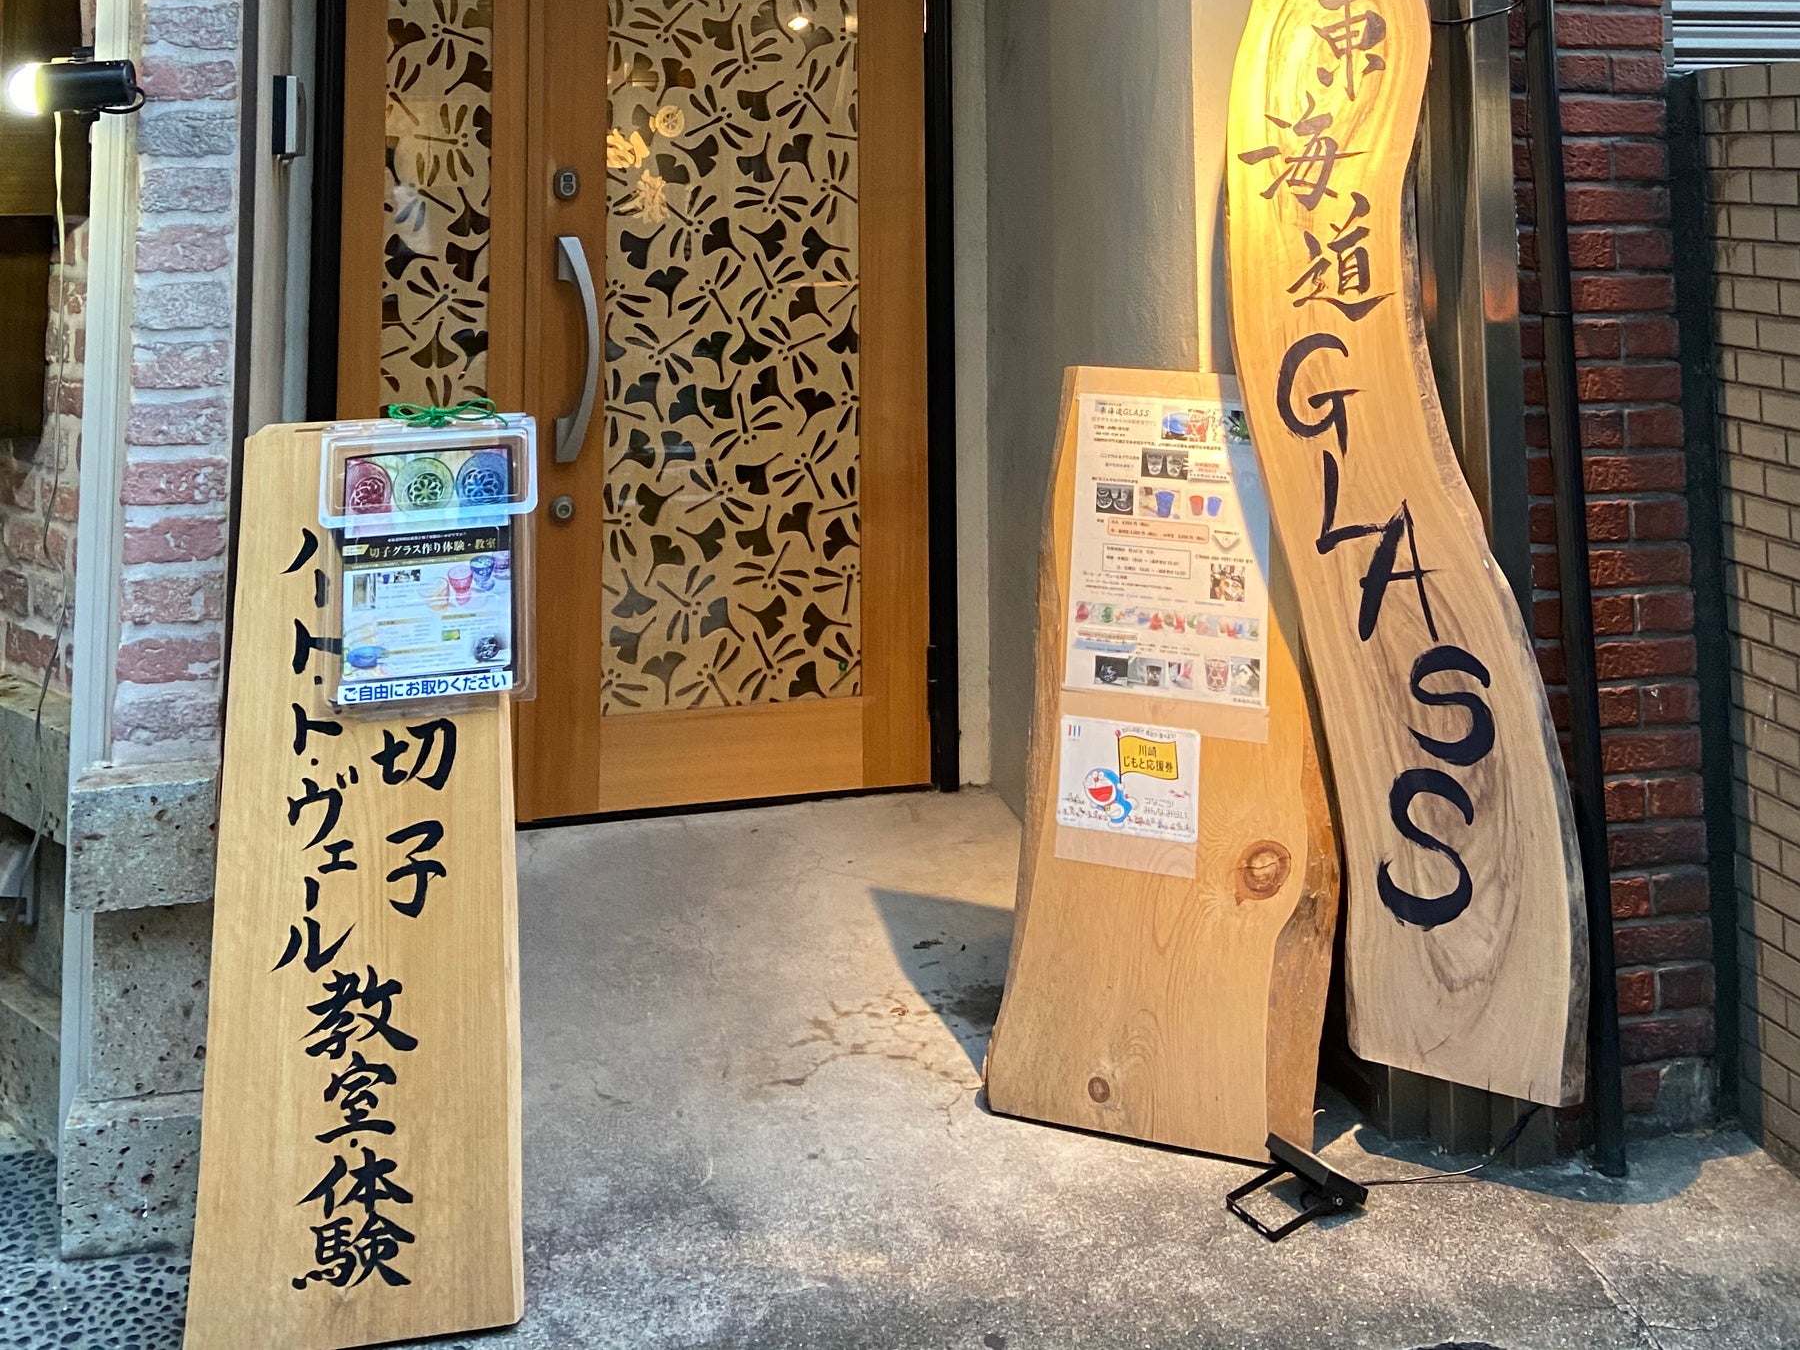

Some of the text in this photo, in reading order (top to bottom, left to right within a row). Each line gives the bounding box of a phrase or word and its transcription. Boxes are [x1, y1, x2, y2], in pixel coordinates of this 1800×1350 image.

[369, 538, 497, 558] 切子グラス作り体験・教室
[344, 674, 507, 702] ご自由にお取りください
[1138, 744, 1157, 758] 川崎
[1123, 755, 1173, 773] じもと応援券
[371, 717, 457, 918] 切子
